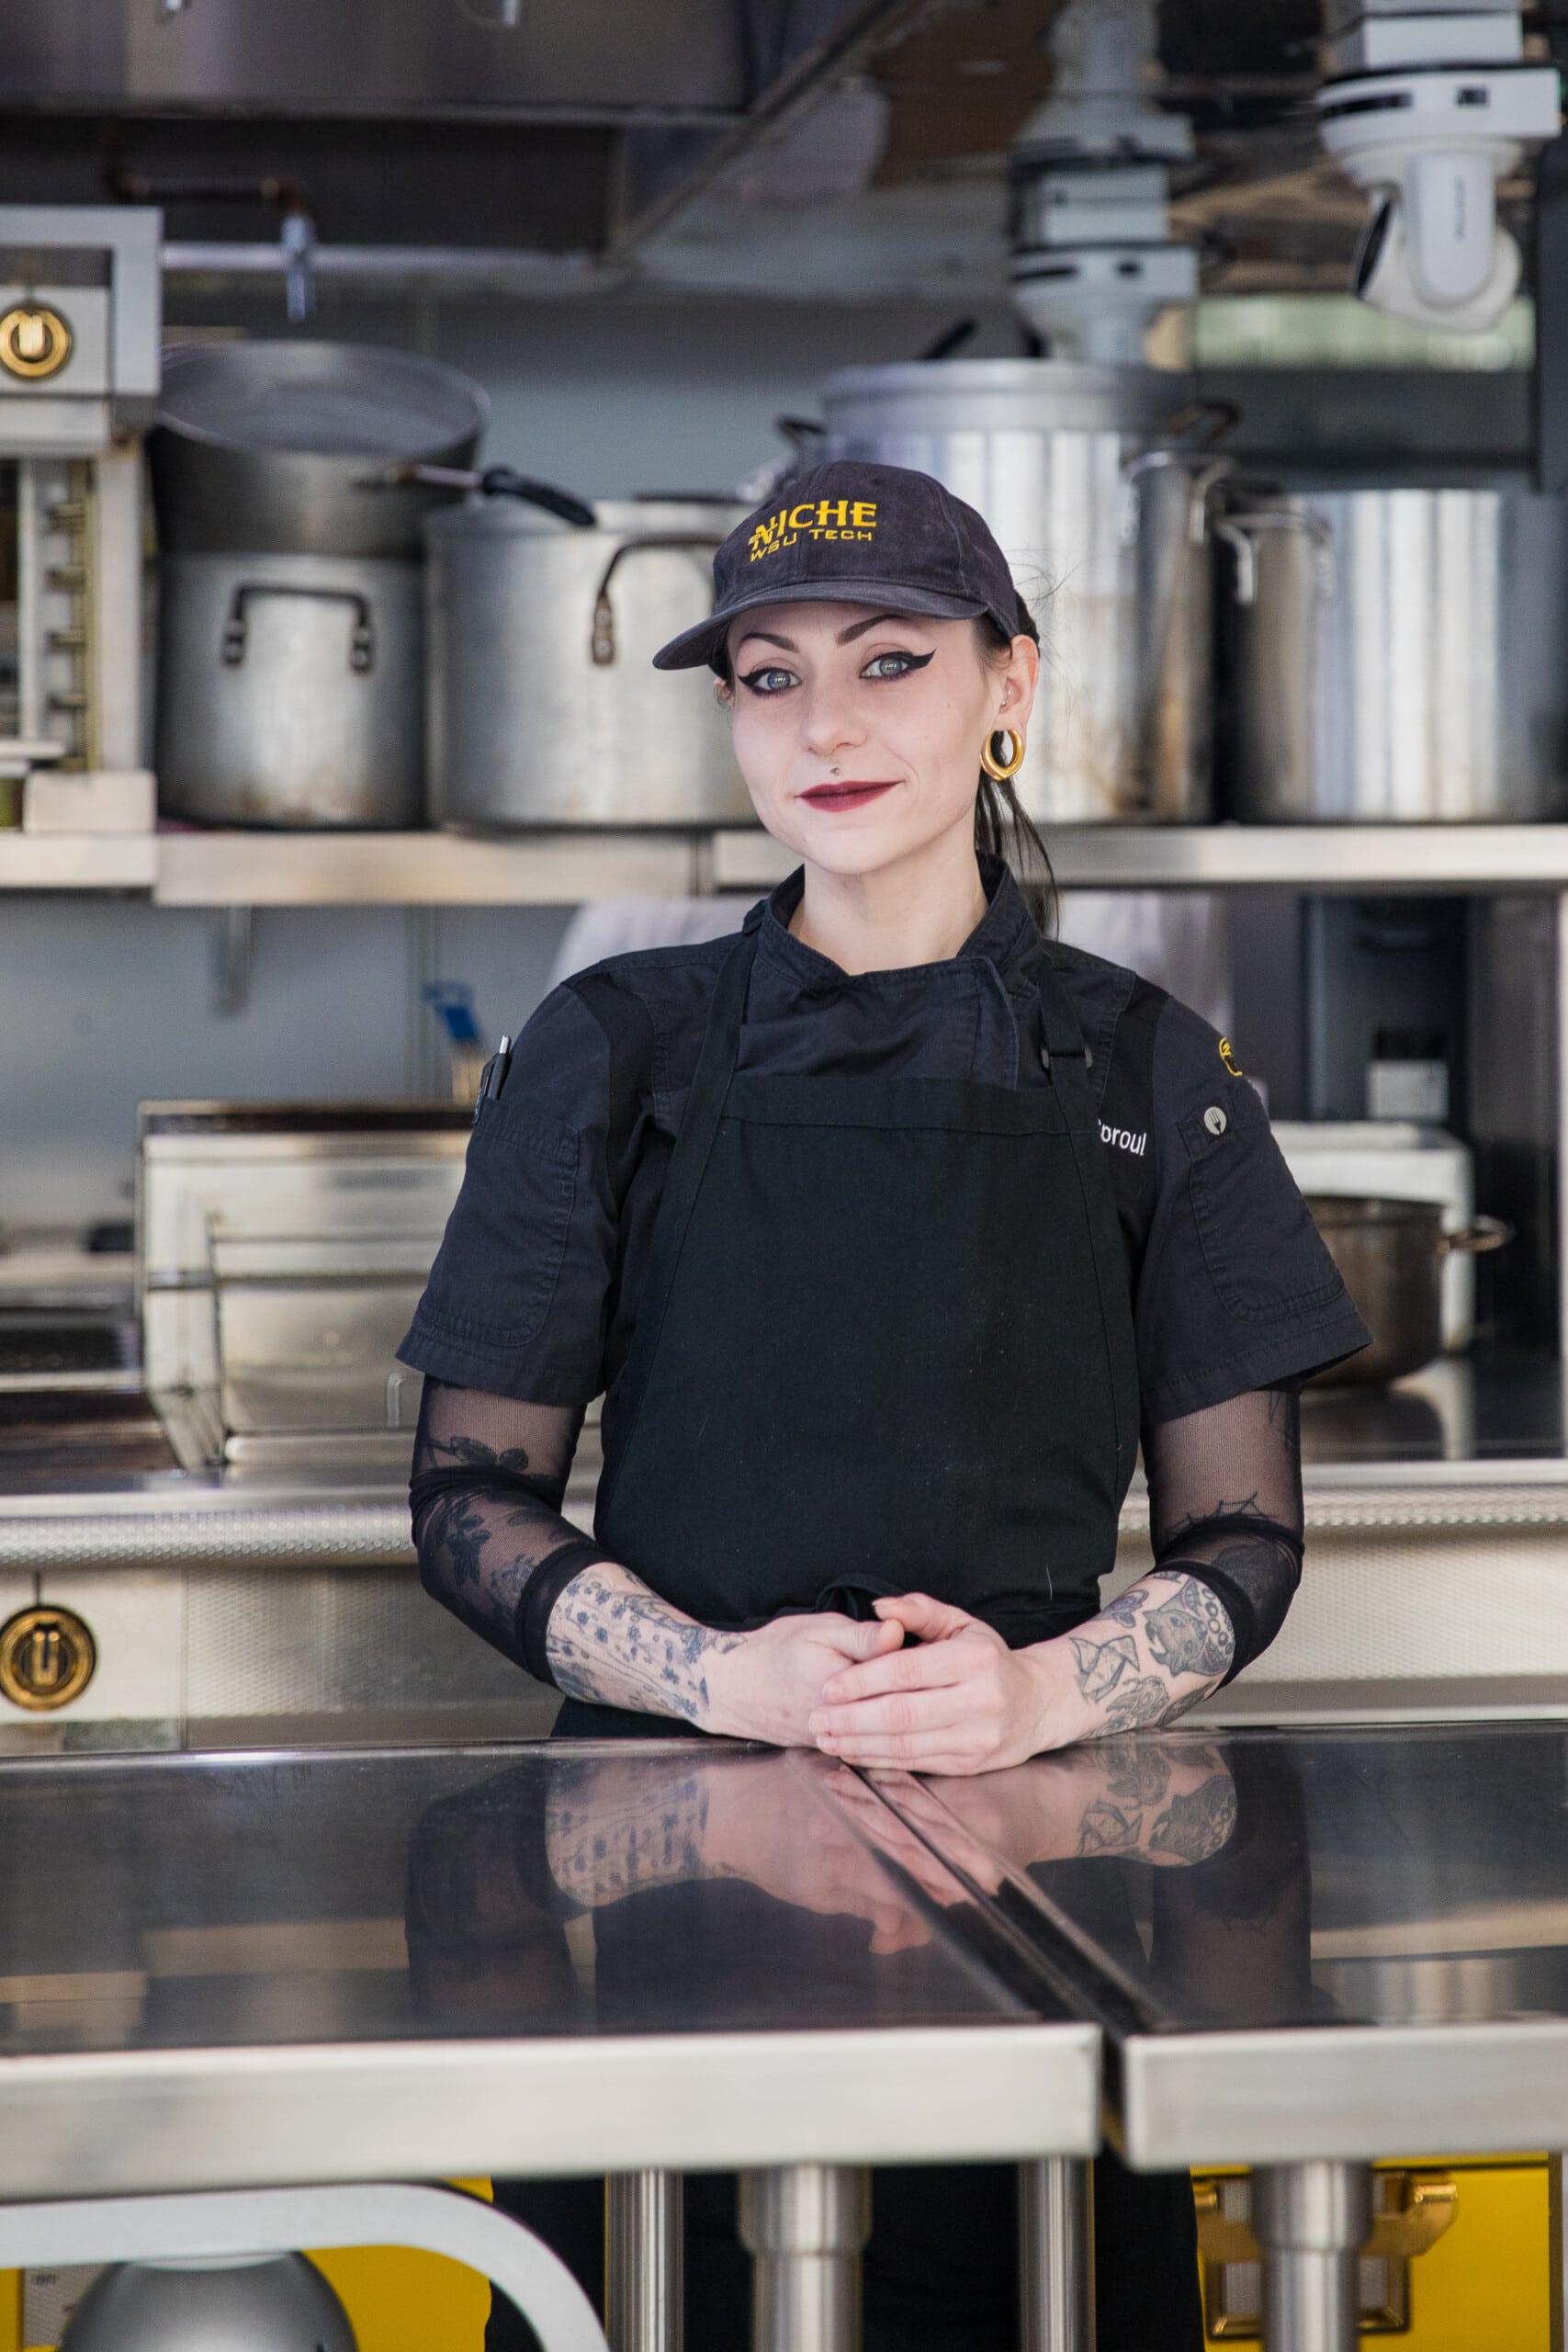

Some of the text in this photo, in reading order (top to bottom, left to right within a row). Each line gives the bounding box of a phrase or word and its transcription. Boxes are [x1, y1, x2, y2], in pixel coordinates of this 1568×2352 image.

[747, 500, 877, 551] NICHE
[750, 528, 873, 562] WSU TECH
[1097, 1118, 1146, 1157] proul
